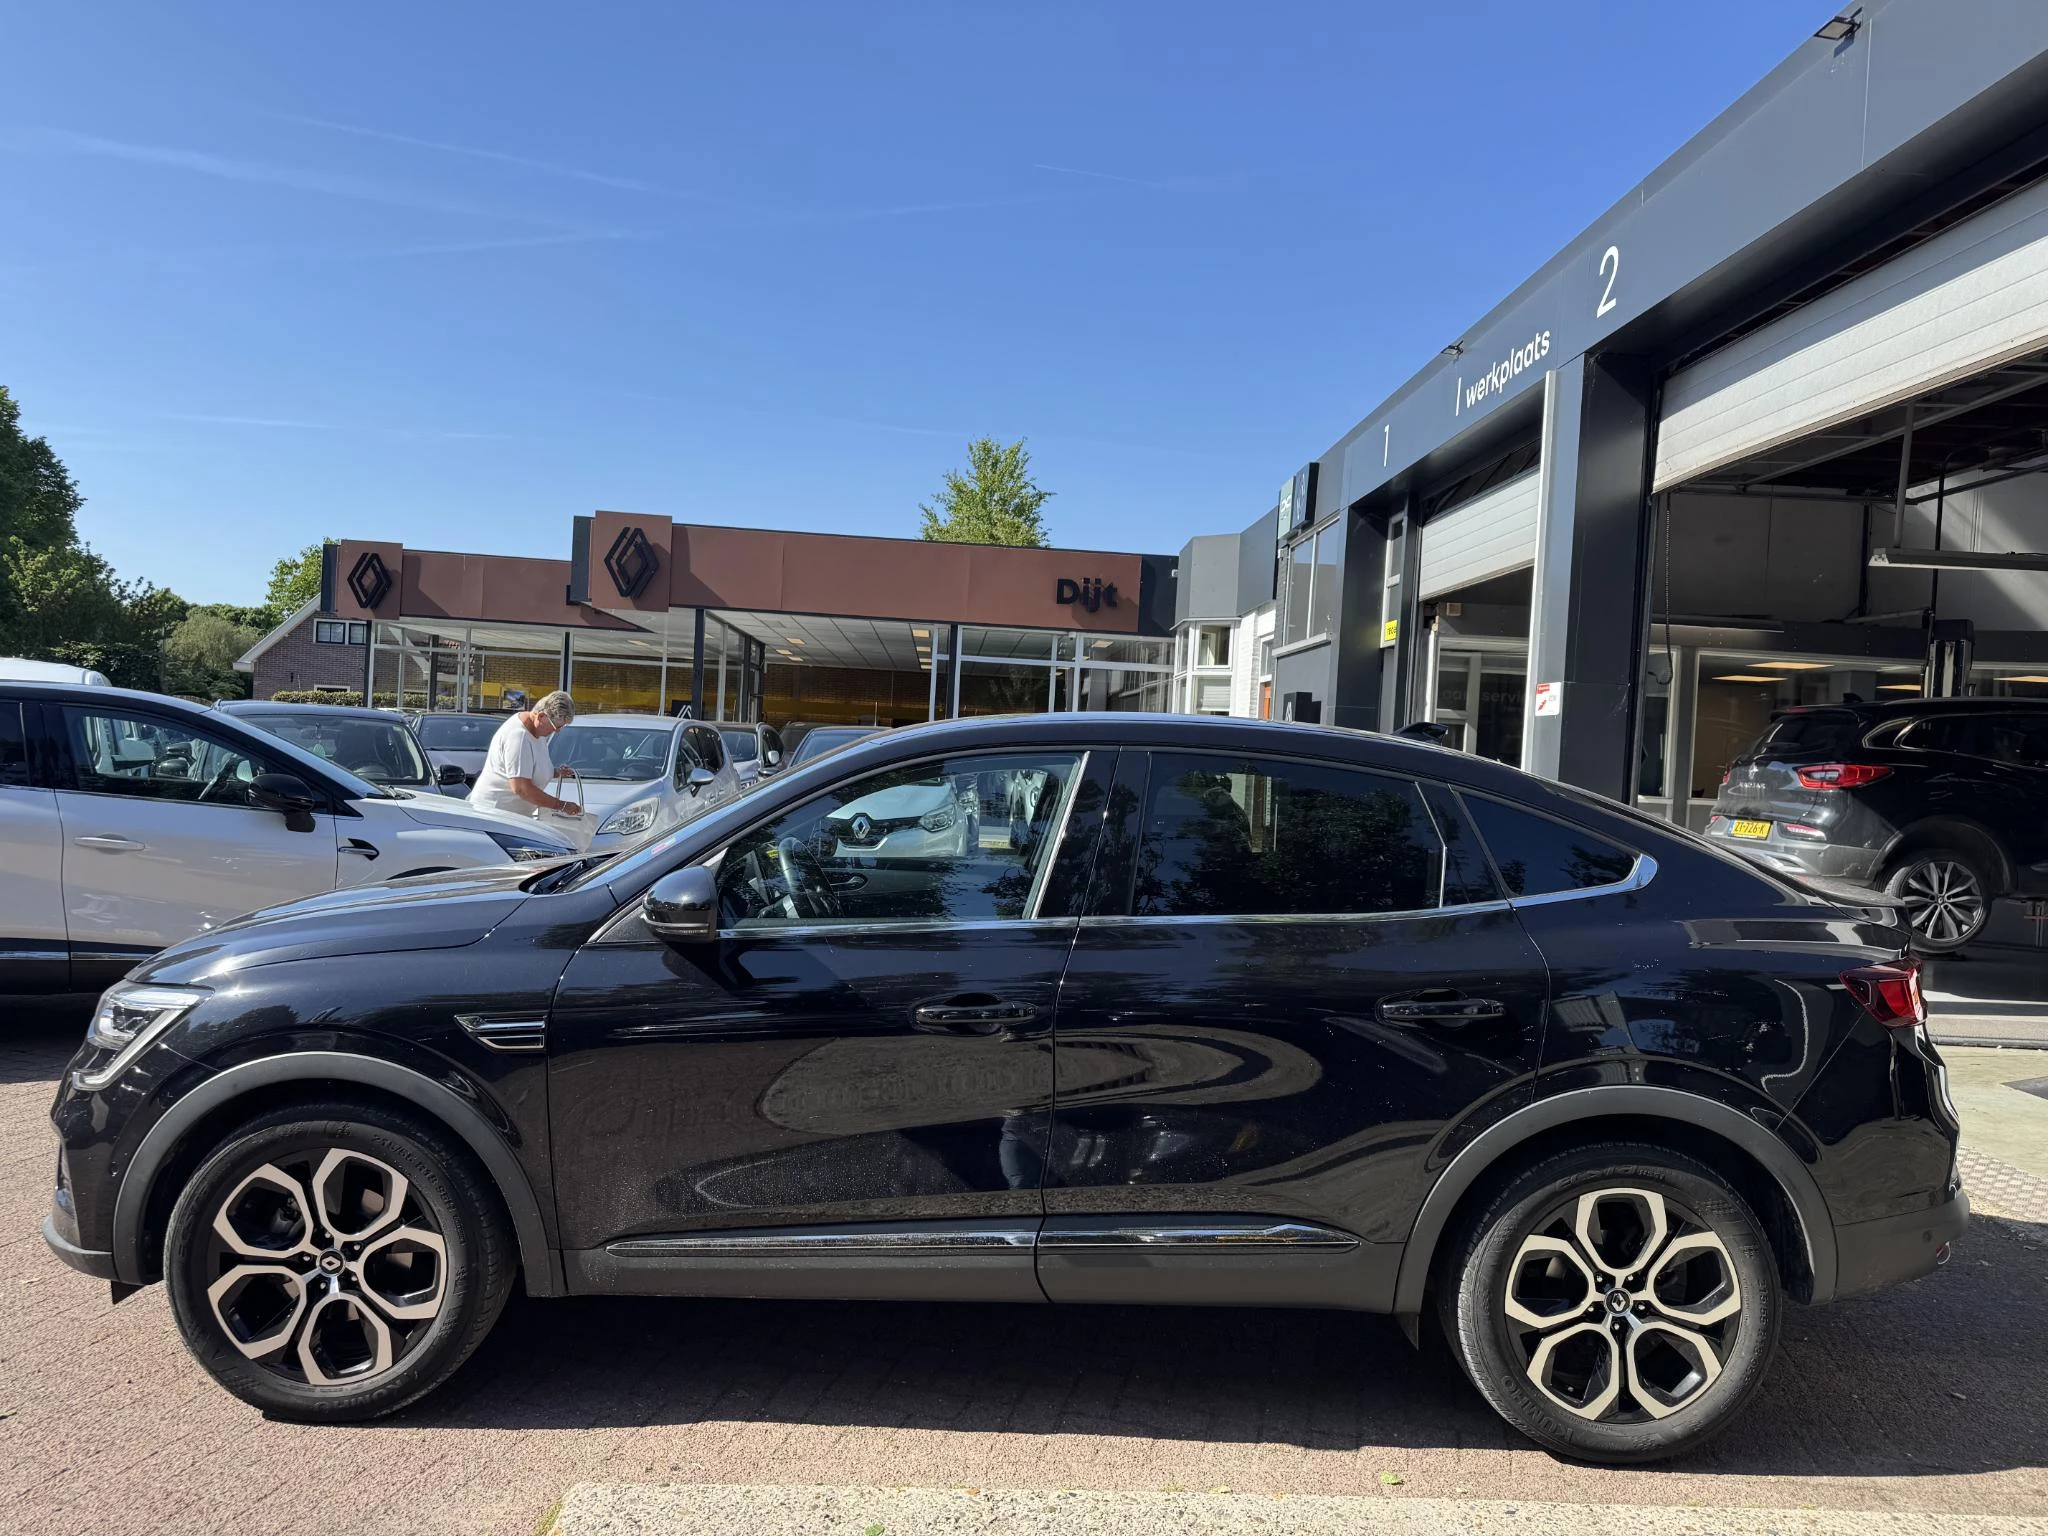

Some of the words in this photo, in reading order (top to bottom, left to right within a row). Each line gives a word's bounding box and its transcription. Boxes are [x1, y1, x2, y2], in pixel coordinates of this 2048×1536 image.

[1596, 245, 1619, 318] 2
[1465, 330, 1551, 409] werkplaats
[1383, 424, 1390, 467] 1
[1056, 577, 1118, 612] Dijt
